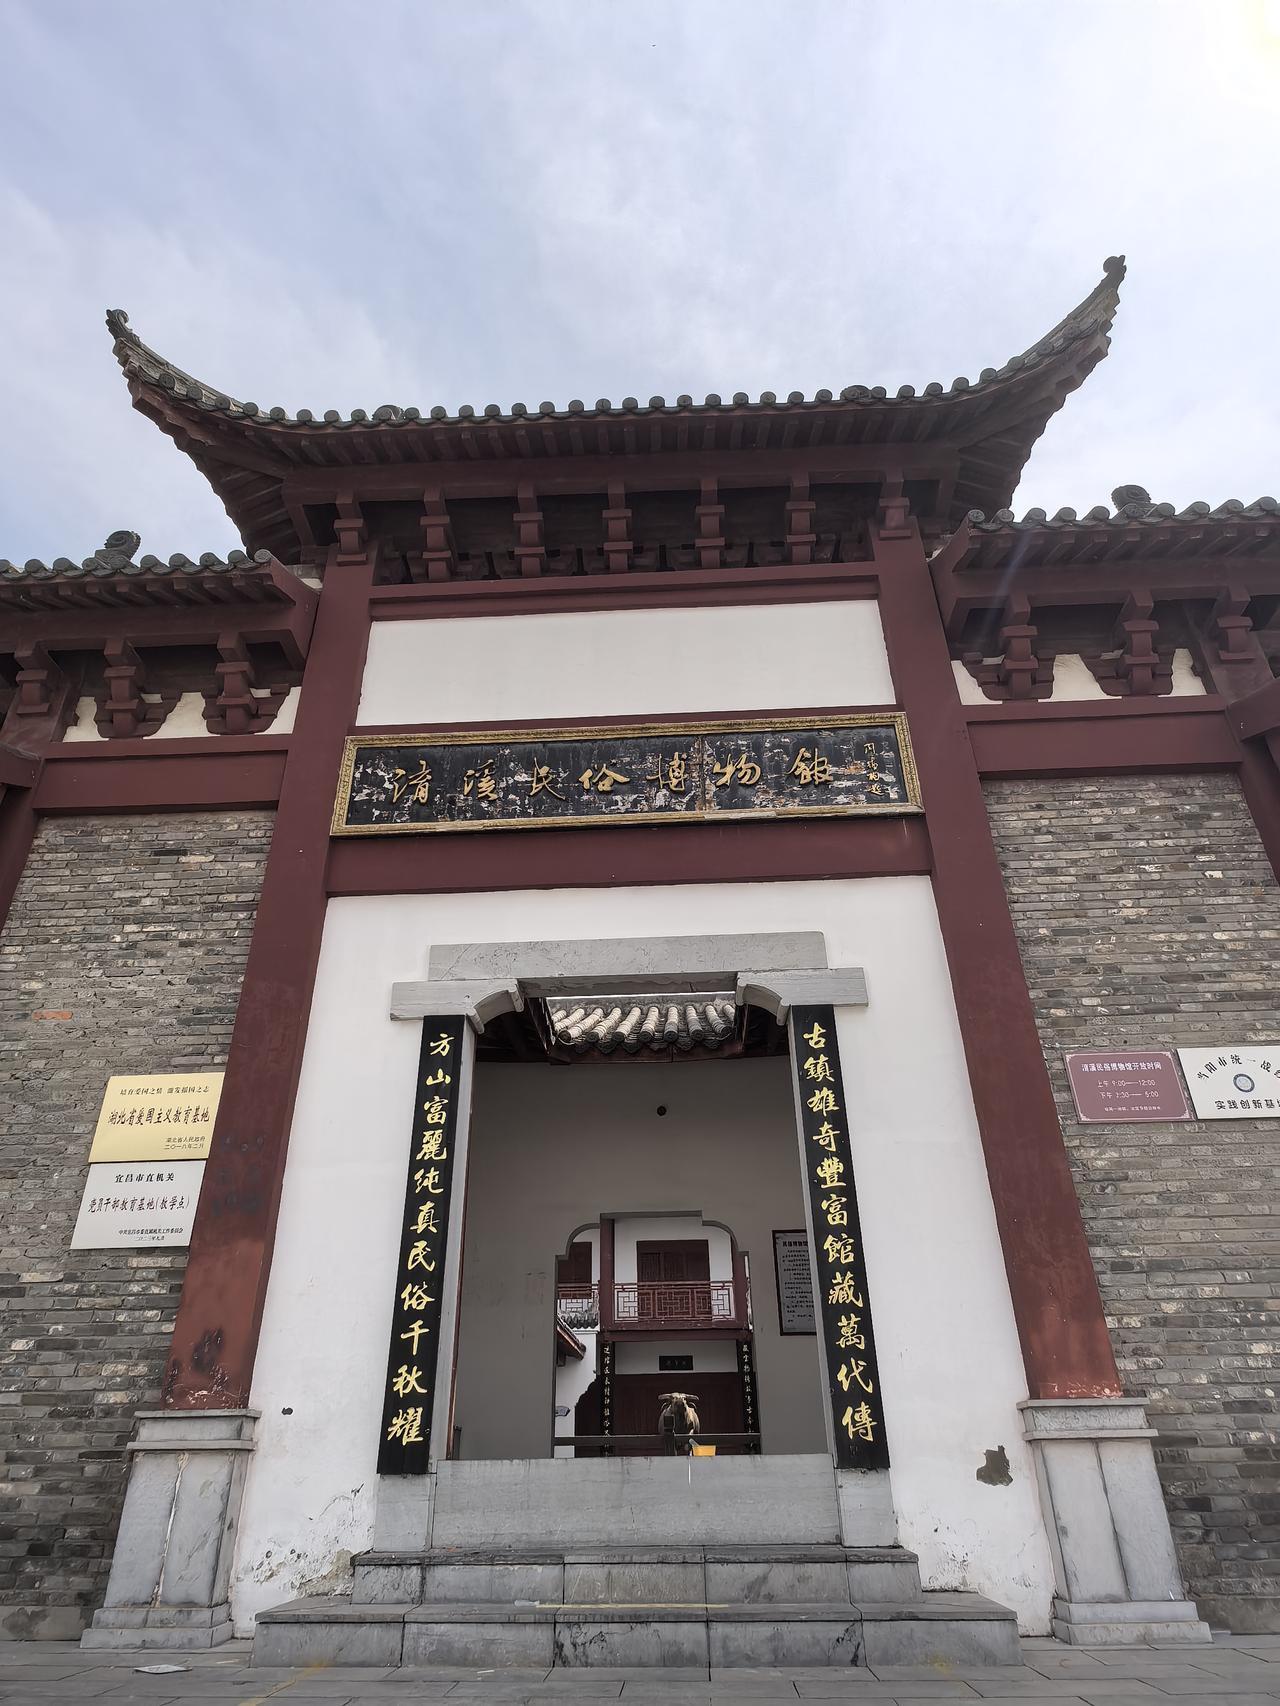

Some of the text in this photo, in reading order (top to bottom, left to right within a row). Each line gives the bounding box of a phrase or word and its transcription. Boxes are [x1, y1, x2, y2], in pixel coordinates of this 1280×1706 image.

[1215, 1099, 1280, 1110] 实践创新基
[108, 1105, 210, 1126] 湖北省爱国主义教育基地
[114, 1172, 175, 1183] 宜昌市直机关
[387, 1033, 455, 1446] 方山富麗純真民俗千秋耀
[803, 1022, 878, 1442] 古鎮雄奇豐富館藏萬代傳
